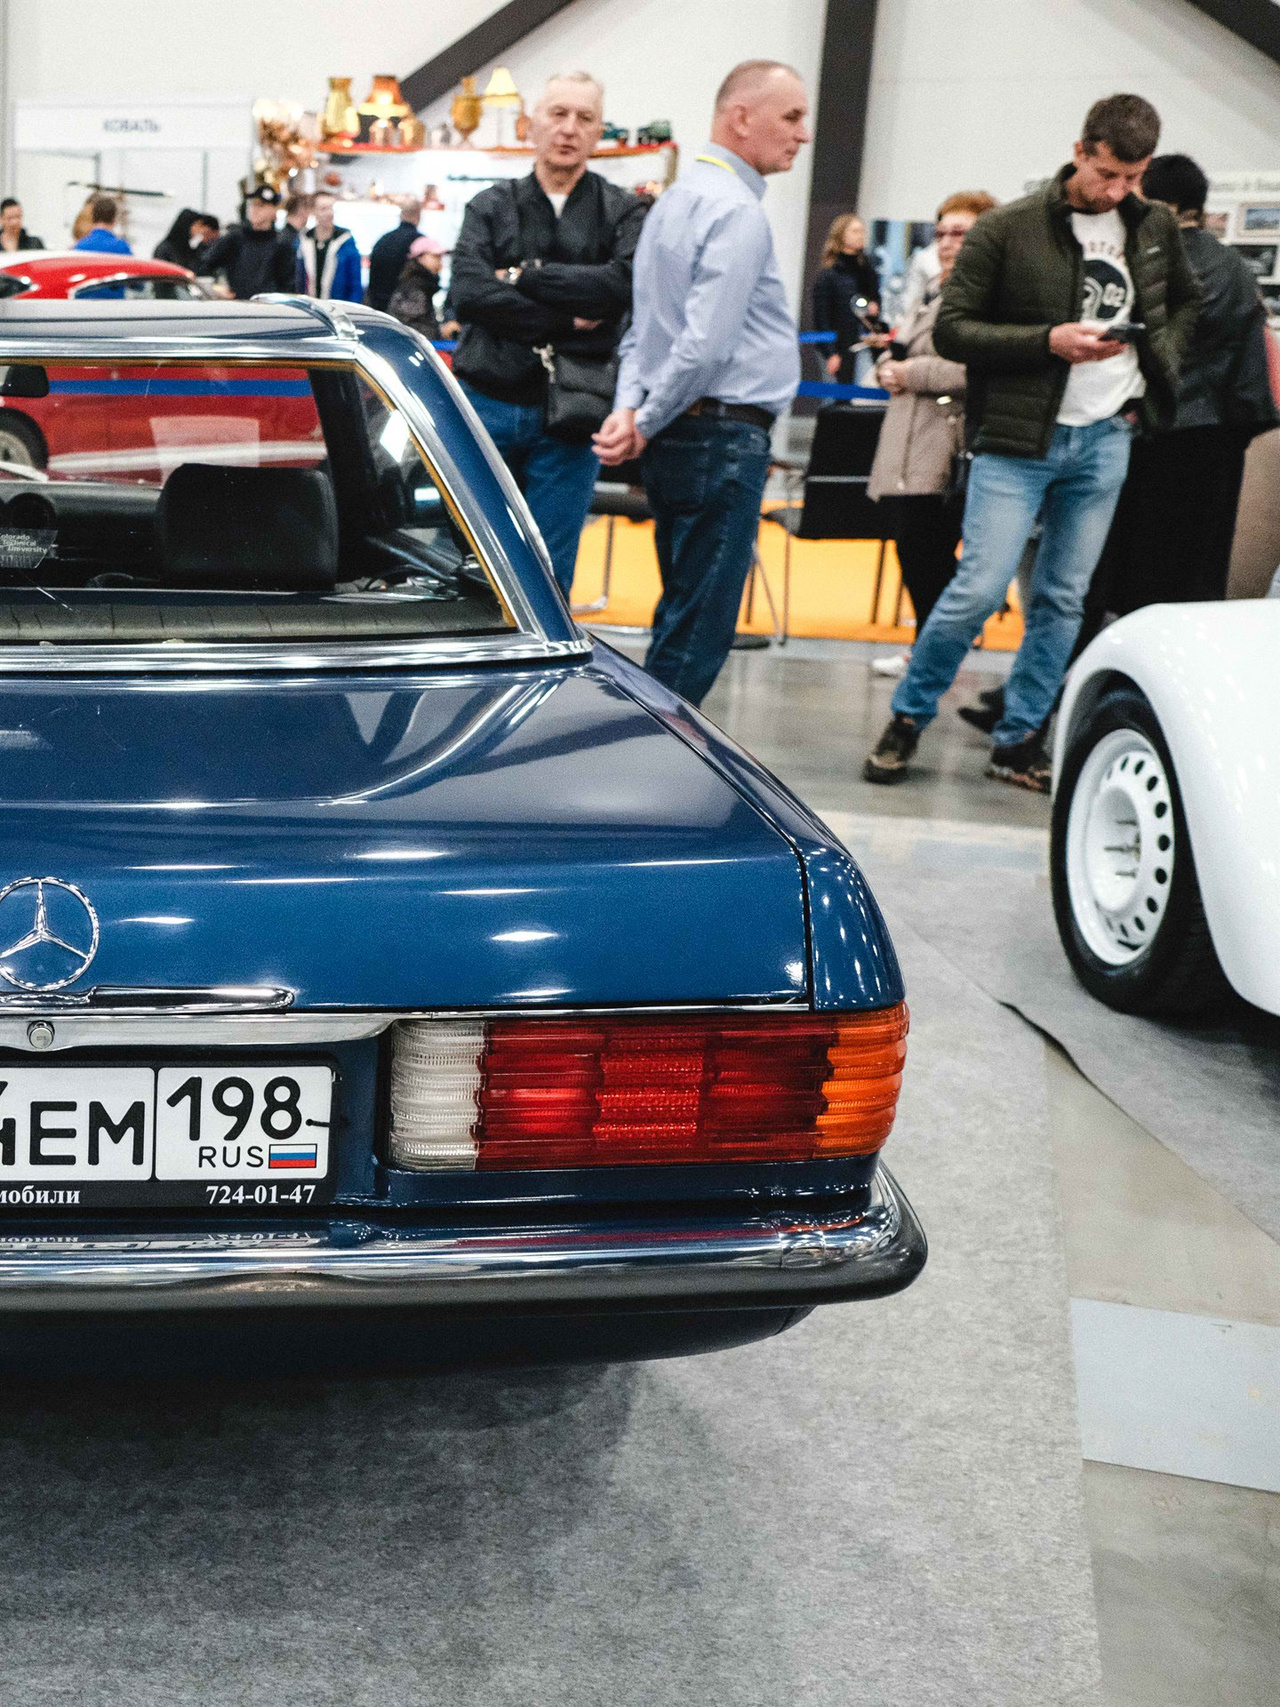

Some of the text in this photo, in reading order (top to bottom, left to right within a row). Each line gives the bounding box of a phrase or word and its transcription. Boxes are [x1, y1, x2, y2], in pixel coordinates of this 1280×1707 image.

[7, 546, 48, 554] University
[166, 1075, 302, 1140] 198
[198, 1146, 264, 1168] RUS
[205, 1184, 316, 1206] 724-01-47
